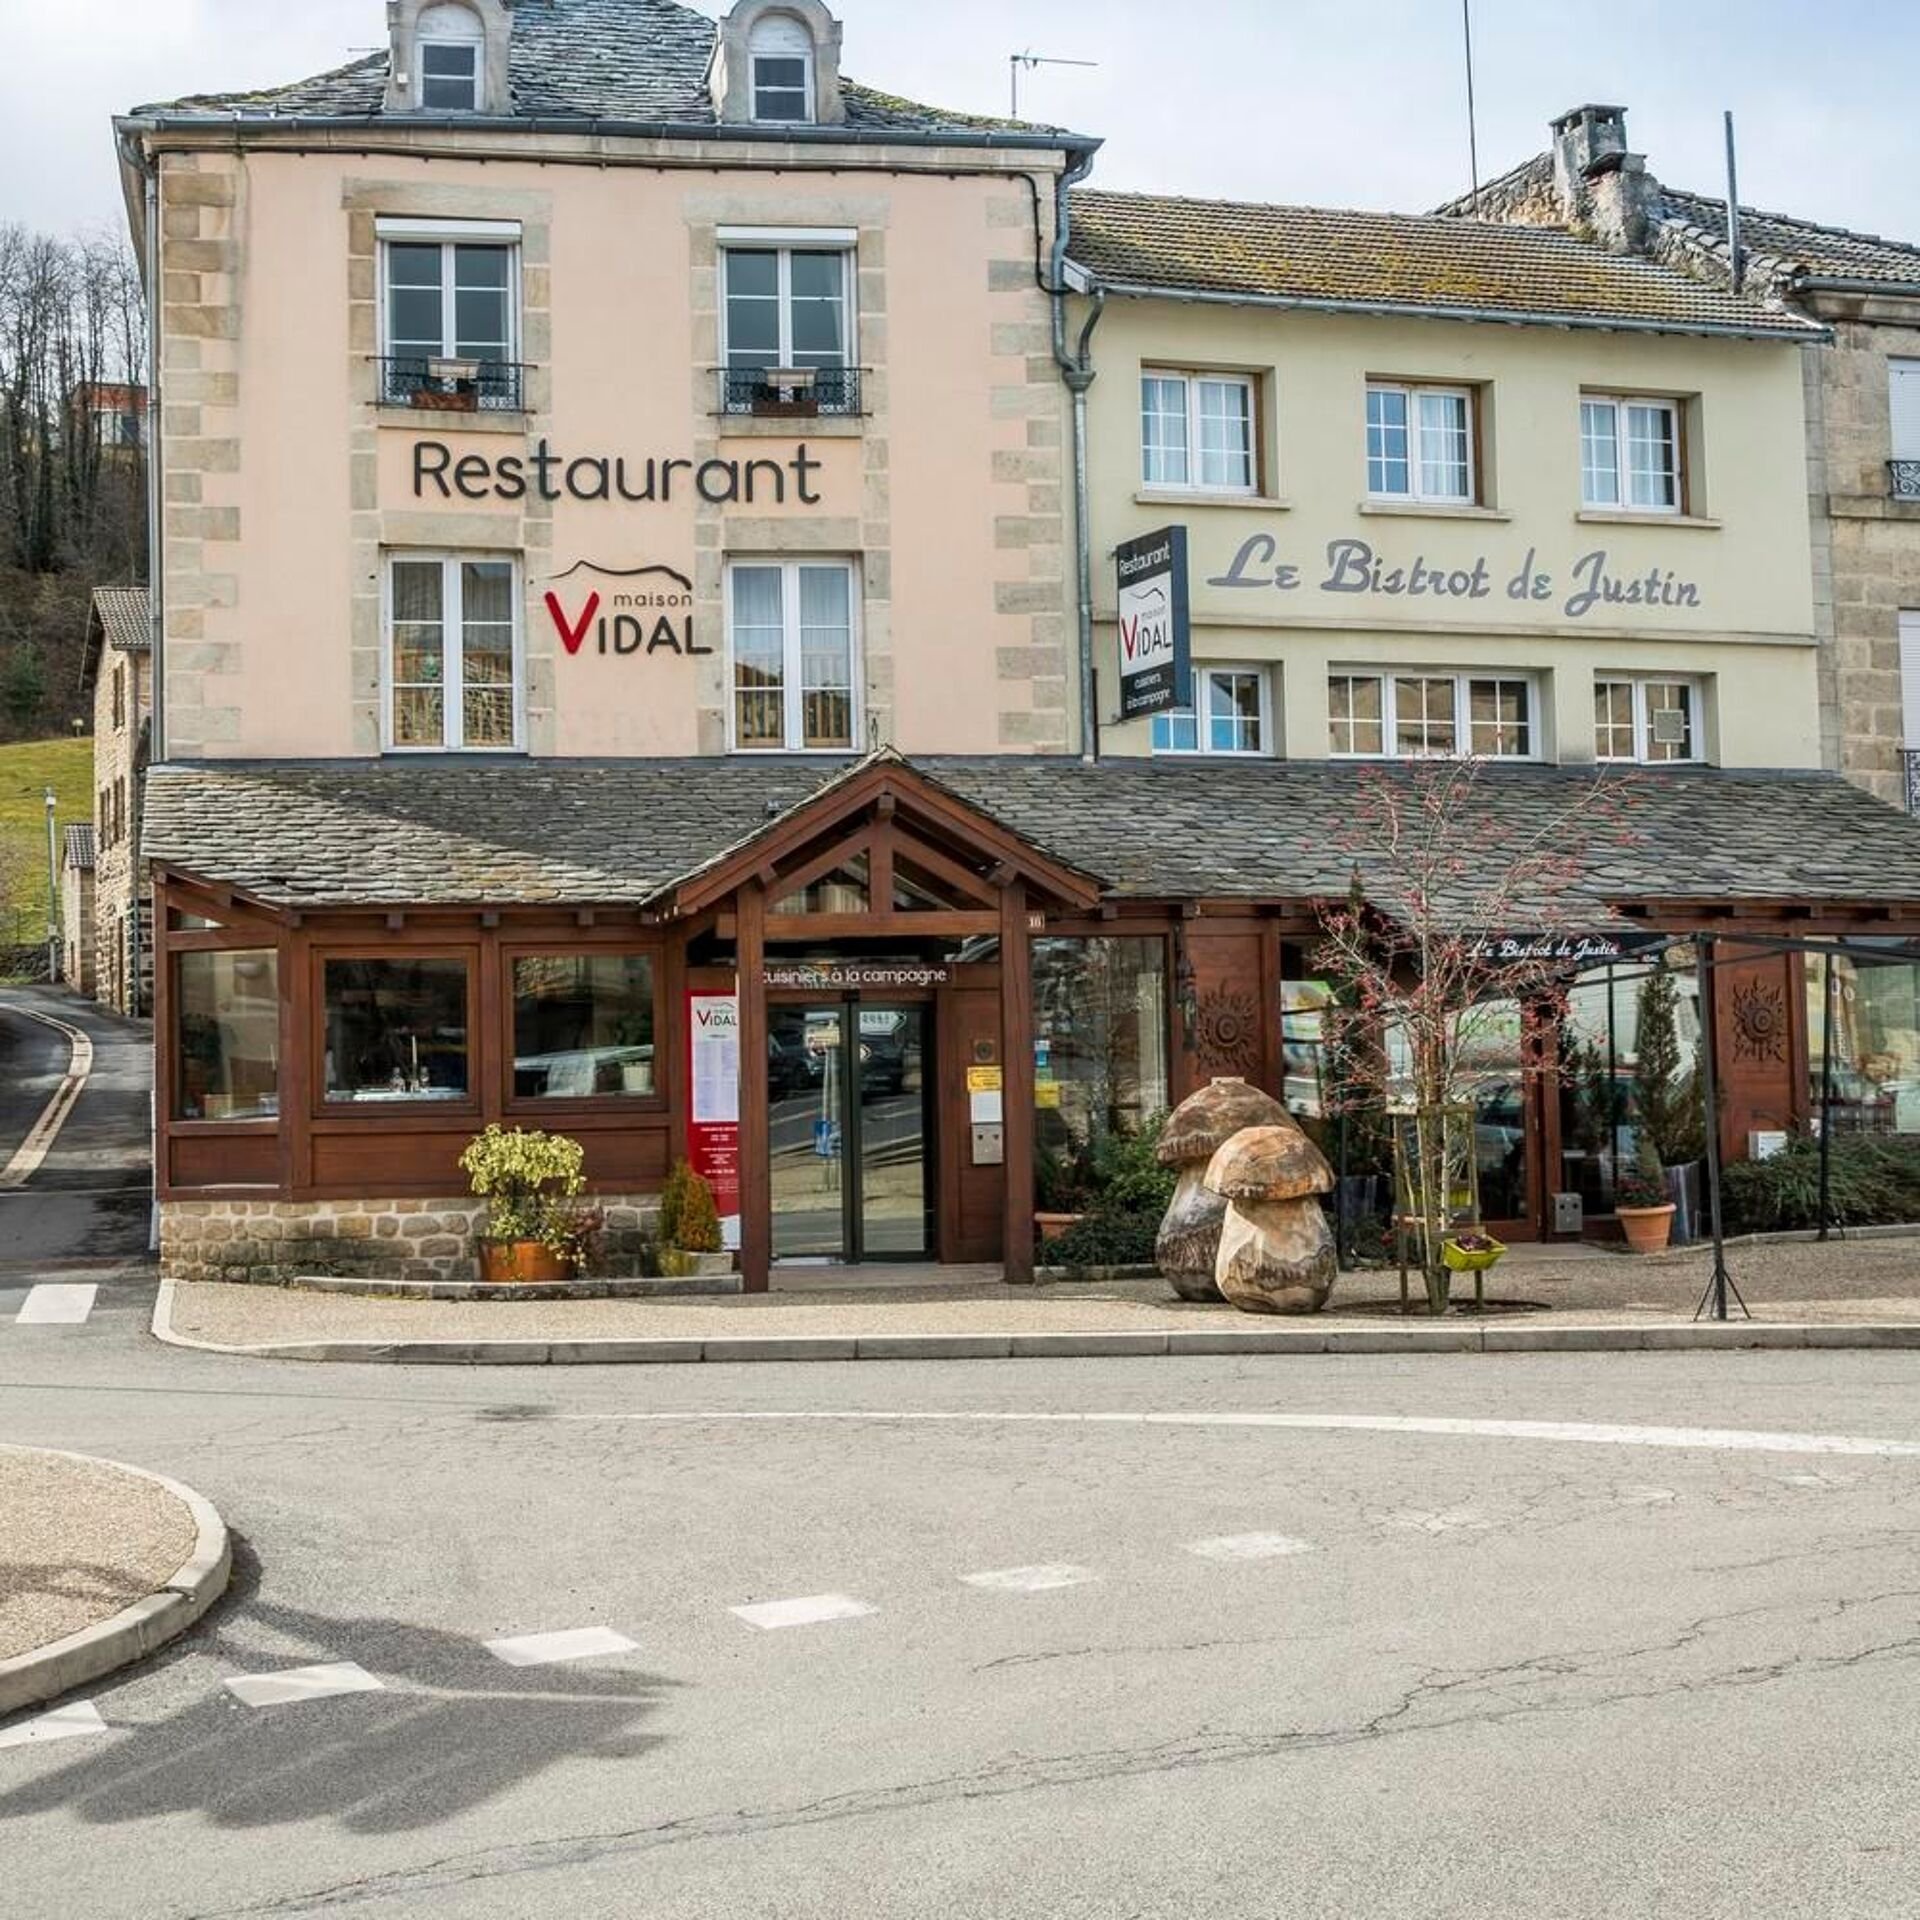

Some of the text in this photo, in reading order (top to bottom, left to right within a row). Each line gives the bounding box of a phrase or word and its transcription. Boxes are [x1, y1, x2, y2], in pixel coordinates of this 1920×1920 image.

[413, 438, 822, 504] Restaurant
[1207, 533, 1700, 617] Le Bistrot de Justin
[613, 591, 692, 607] maison
[544, 591, 713, 655] VIDAL
[1121, 614, 1172, 661] VIDAL
[845, 966, 860, 983] la
[862, 968, 947, 986] campagne
[697, 1009, 737, 1026] VIDAL
